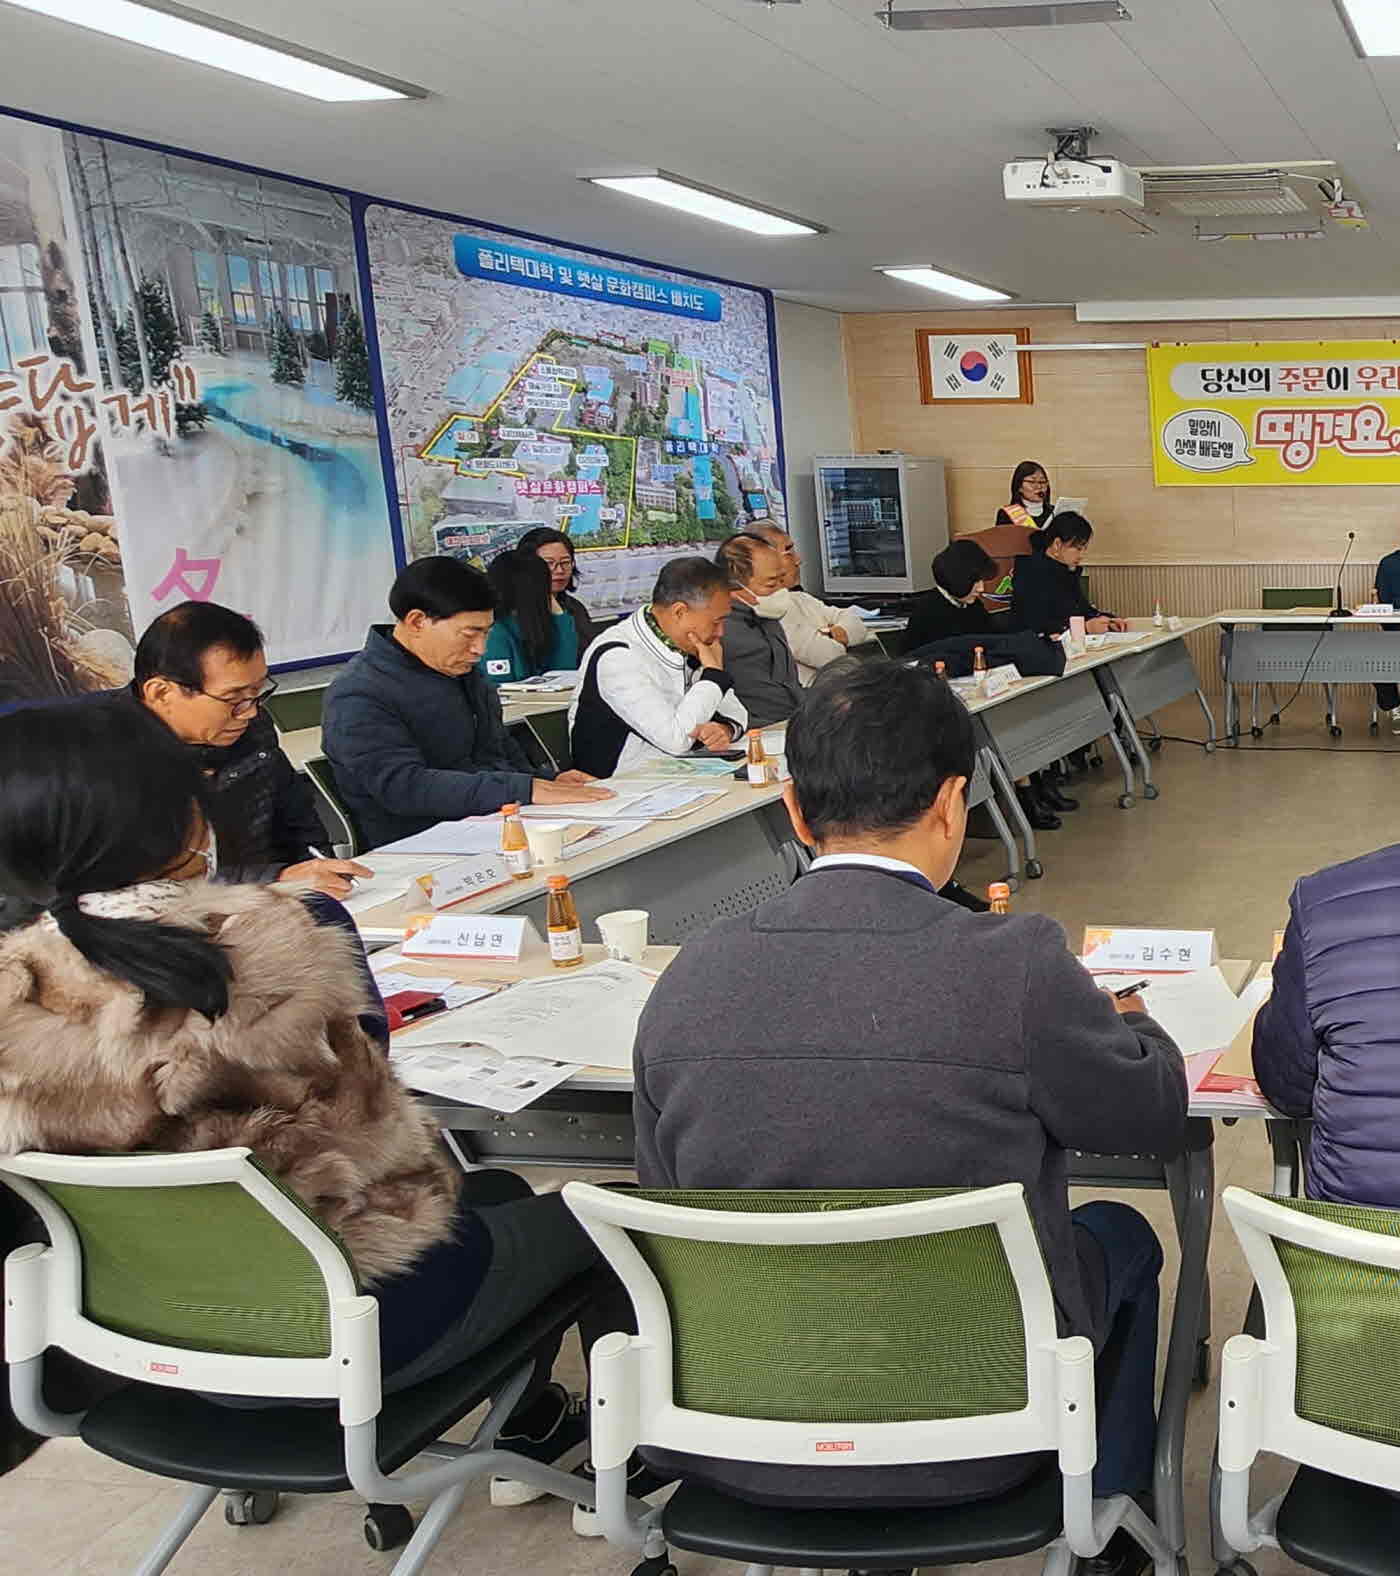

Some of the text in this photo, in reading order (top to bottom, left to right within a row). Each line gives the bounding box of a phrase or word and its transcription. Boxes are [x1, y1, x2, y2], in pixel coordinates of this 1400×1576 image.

[478, 248, 554, 281] 폴리텍대학
[558, 266, 574, 286] 및
[576, 271, 604, 292] 햇살
[606, 277, 668, 304] 문화캠퍼스
[1201, 367, 1270, 393] 당신의
[1278, 367, 1349, 392] 주문이
[1188, 418, 1220, 437] 밀양시
[1174, 438, 1234, 459] 상생 배달앱
